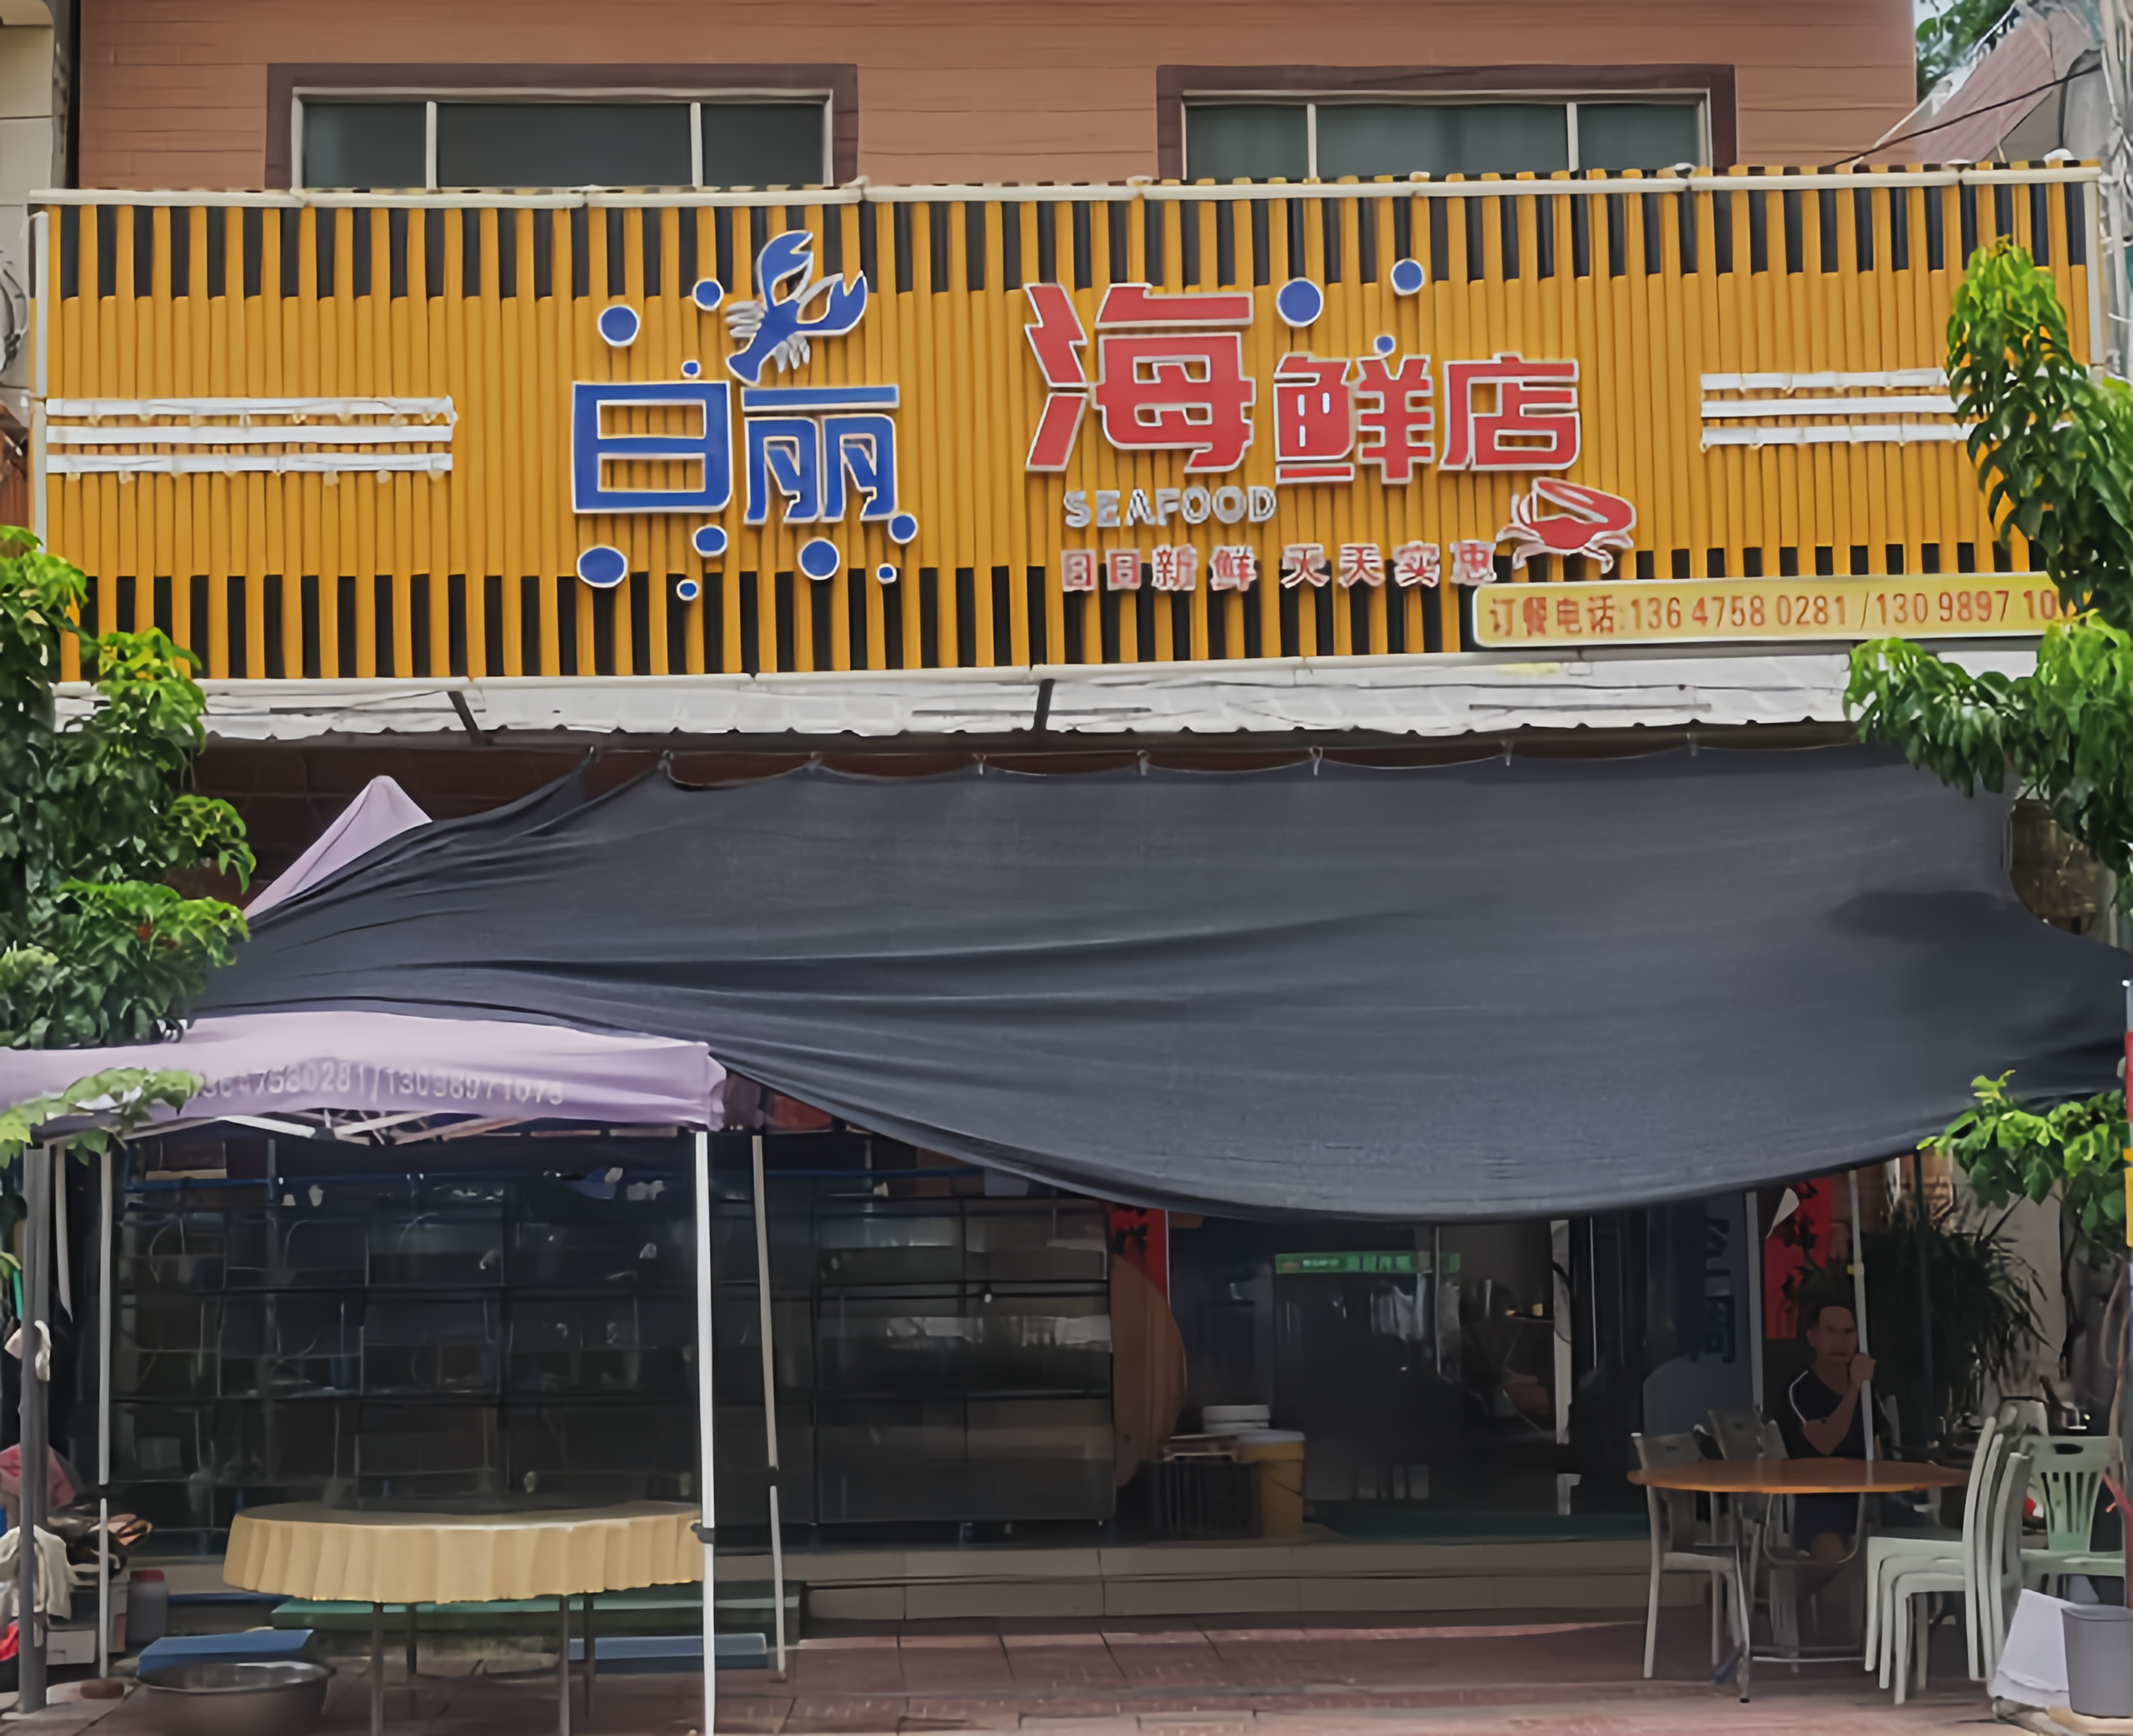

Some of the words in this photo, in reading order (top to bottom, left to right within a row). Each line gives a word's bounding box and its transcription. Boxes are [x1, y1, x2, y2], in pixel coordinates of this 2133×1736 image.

[1023, 282, 1581, 485] 海鲜店
[572, 381, 900, 525] 日丽
[1063, 486, 1276, 528] SEAFOOD
[1776, 594, 1846, 626] 0281
[1939, 590, 2010, 624] 9897
[2023, 589, 2057, 621] 10
